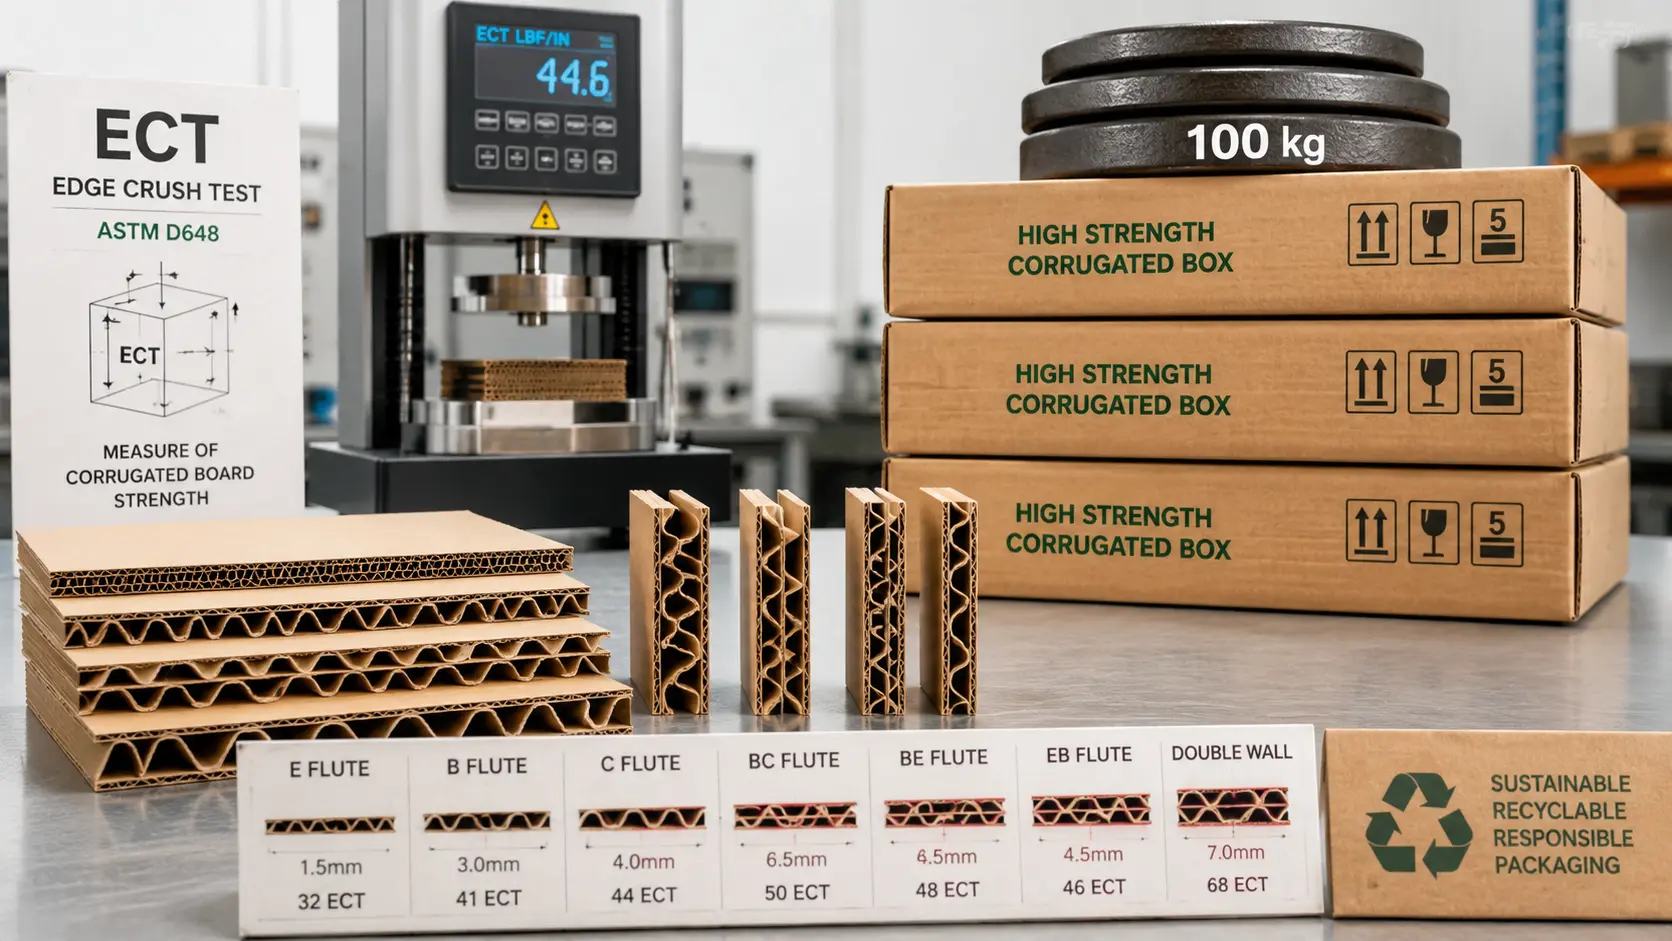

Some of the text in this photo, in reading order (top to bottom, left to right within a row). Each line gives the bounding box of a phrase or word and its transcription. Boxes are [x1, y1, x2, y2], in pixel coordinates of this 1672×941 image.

[476, 25, 570, 46] ECT LBF/IN
[536, 58, 611, 97] 44.6
[97, 108, 219, 163] ECT
[1188, 123, 1325, 165] 100 kg
[53, 177, 261, 202] EDGE CRUSH TEST
[1490, 208, 1506, 232] 5
[97, 222, 219, 242] ASTM D648
[1019, 221, 1214, 245] HIGH STRENGTH
[1008, 252, 1233, 275] CORRUGATED BOX
[121, 346, 160, 364] ECT
[1016, 364, 1211, 384] HIGH STRENGTH
[1488, 358, 1506, 383] 5
[1006, 394, 1231, 415] CORRUGATED BOX
[104, 443, 218, 459] MEASURE OF
[66, 466, 254, 485] CORRUGATED BOARD
[115, 491, 208, 508] STRENGTH
[1016, 503, 1211, 528] HIGH STRENGTH
[1488, 511, 1506, 535] 5
[1007, 533, 1231, 560] CORRUGATED BOX
[749, 752, 839, 769] BC FLUTE
[901, 749, 987, 766] BE FLUTE
[1047, 747, 1132, 763] EB FLUTE
[1172, 744, 1292, 760] DOUBLE WALL
[291, 760, 369, 777] E FLUTE
[448, 758, 527, 774] B FLUTE
[601, 755, 680, 772] C FLUTE
[1491, 774, 1631, 792] SUSTAINABLE
[1493, 802, 1626, 820] RECYCLABLE
[1494, 829, 1634, 847] RESPONSIBLE
[767, 852, 826, 867] 6.5mm
[1064, 847, 1123, 861] 4.5mm
[1208, 845, 1264, 859] 7.0mm
[301, 859, 362, 875] 1.5mm
[458, 857, 519, 872] 3.0mm
[613, 854, 674, 869] 4.0mm
[1496, 856, 1620, 874] PACKAGING
[766, 884, 830, 900] 50 ECT
[916, 882, 980, 898] 48 ECT
[1063, 879, 1126, 895] 46 ECT
[1208, 877, 1268, 892] 68 ECT
[299, 893, 365, 910] 32 ECT
[456, 890, 522, 906] 41 ECT
[612, 887, 677, 903] 44 ECT
